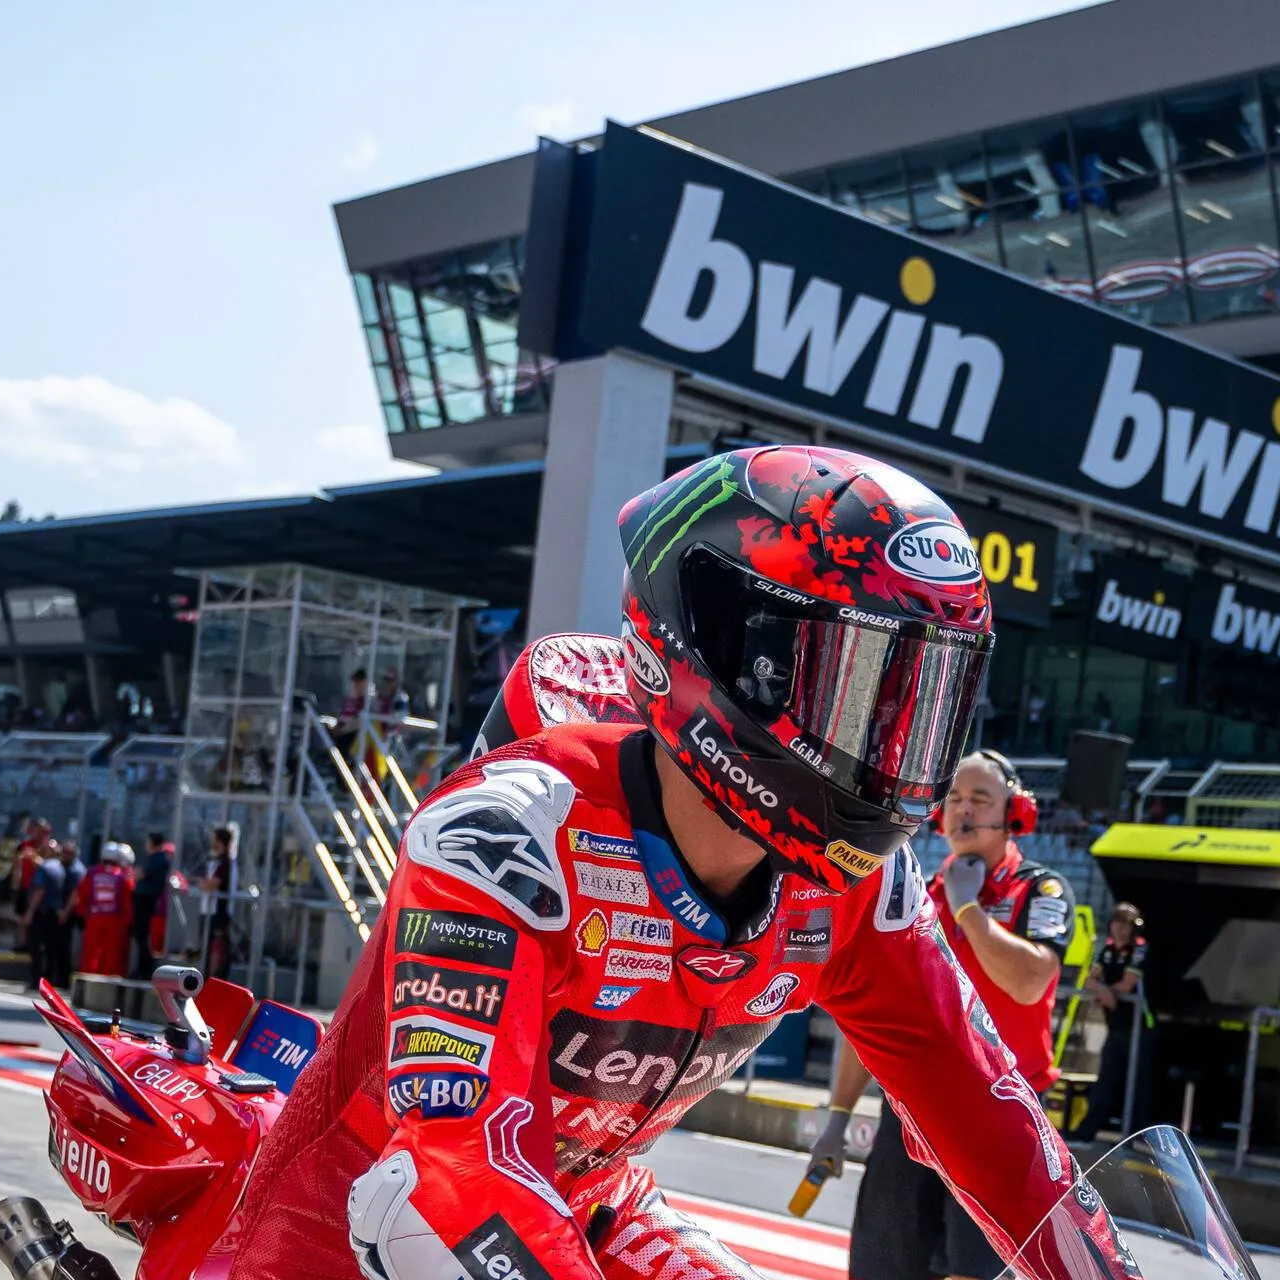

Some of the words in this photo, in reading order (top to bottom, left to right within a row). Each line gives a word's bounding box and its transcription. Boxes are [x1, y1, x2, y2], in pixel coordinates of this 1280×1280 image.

[640, 183, 1004, 445] bwin
[973, 531, 1038, 593] 01
[754, 580, 815, 605] SUOMY
[1098, 579, 1182, 640] bwin
[839, 607, 900, 631] CARRERA
[928, 629, 977, 643] MONSTER
[690, 717, 779, 808] Lenovo
[789, 736, 821, 770] C.G.R.D.
[672, 890, 711, 931] TIM
[748, 873, 784, 941] Lenov
[432, 920, 508, 945] MONSTER
[439, 936, 495, 950] ENERGY
[630, 919, 671, 941] riello
[790, 931, 827, 943] Lenovo
[608, 955, 671, 974] CARRERA
[394, 972, 502, 1018] aruba.it
[596, 988, 632, 1007] SAP
[272, 1036, 309, 1070] TIM
[133, 1062, 207, 1103] GELLIFY
[61, 1128, 111, 1194] iello
